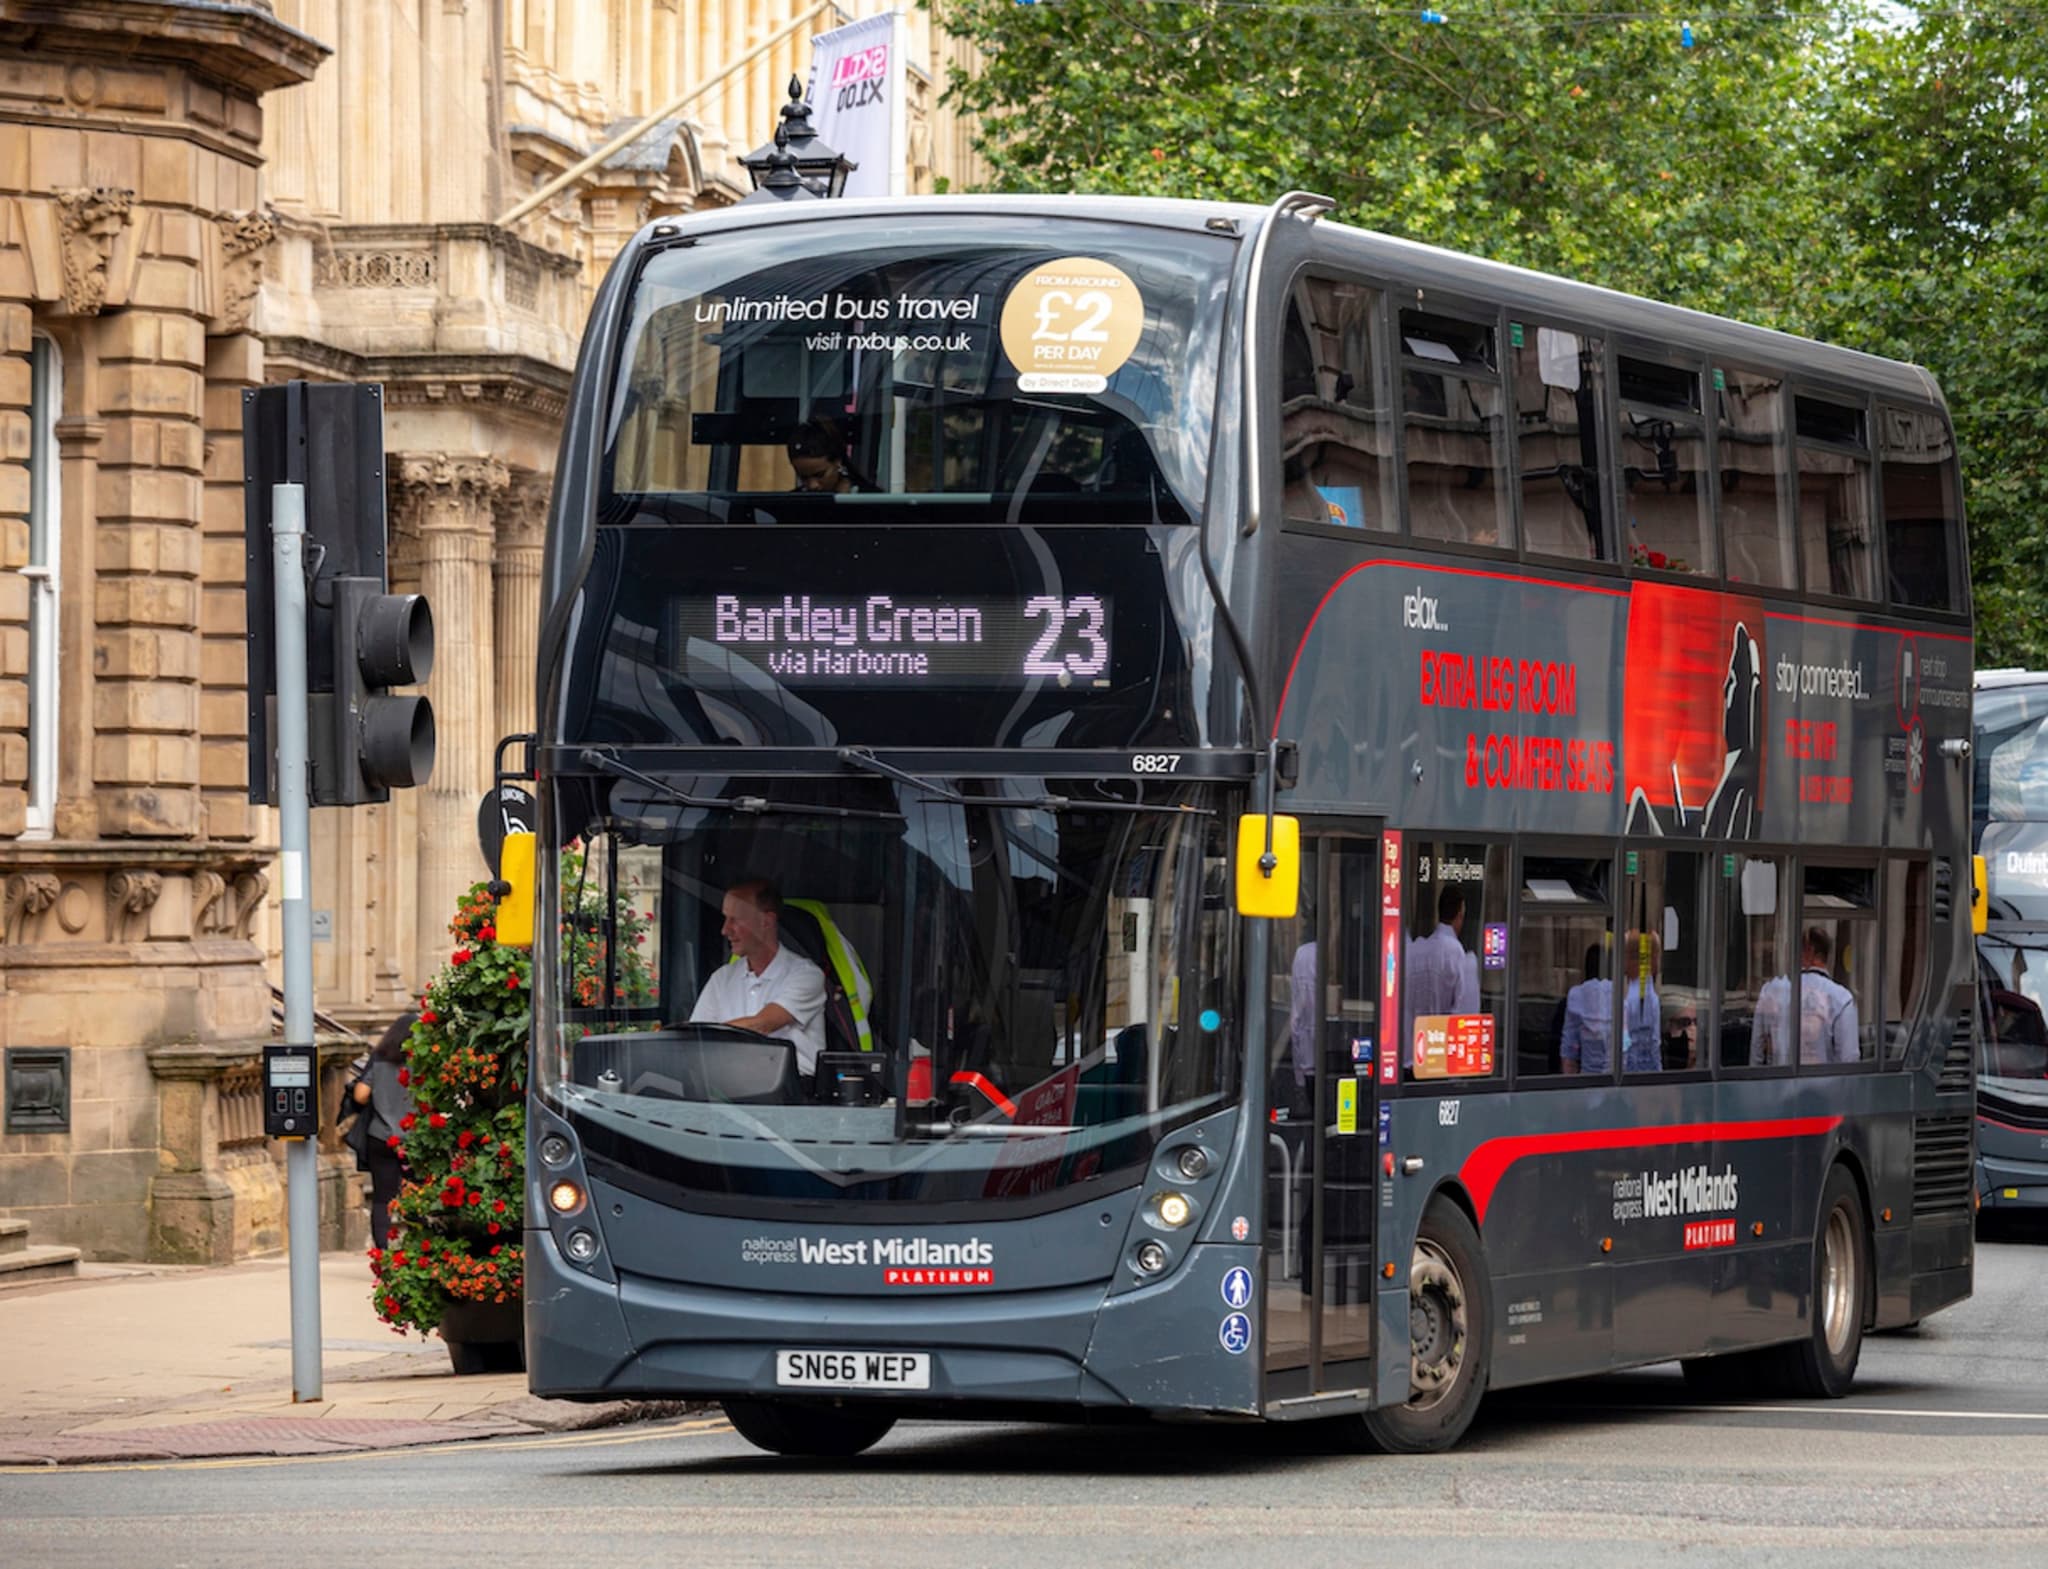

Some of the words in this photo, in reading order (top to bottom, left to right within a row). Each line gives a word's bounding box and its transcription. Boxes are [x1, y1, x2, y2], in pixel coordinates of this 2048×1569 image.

[1035, 275, 1070, 287] FROM
[1071, 276, 1121, 288] AROUND
[694, 294, 828, 322] unlimited
[834, 293, 889, 320] bus
[897, 293, 979, 320] travel
[1031, 290, 1113, 342] £2
[805, 332, 841, 350] visit
[847, 332, 971, 351] nxbus.co.uk
[1033, 345, 1064, 360] PER
[1067, 345, 1103, 361] DAY
[716, 596, 858, 645] Bartley
[866, 596, 982, 642] Green
[1403, 586, 1449, 632] relax...
[1023, 596, 1108, 676] 23
[769, 649, 807, 674] via
[812, 649, 929, 674] Harborne
[1420, 648, 1478, 710] EXTRA
[1481, 655, 1515, 713] LEG
[1518, 658, 1576, 717] ROOM
[1776, 653, 1800, 703] stay
[1132, 754, 1181, 773] 6827
[1465, 731, 1480, 789] &
[1566, 738, 1615, 795] SEATS
[1439, 1100, 1460, 1125] 6827
[1643, 1170, 1678, 1217] West
[1679, 1163, 1738, 1215] Midlands
[742, 1236, 797, 1251] national
[1684, 1222, 1736, 1247] PLATINUM
[743, 1250, 797, 1265] express
[799, 1238, 868, 1265] West
[872, 1237, 993, 1265] Midlands
[888, 1270, 990, 1283] PLATINUM
[788, 1353, 857, 1381] SN66
[865, 1355, 917, 1382] WEP
